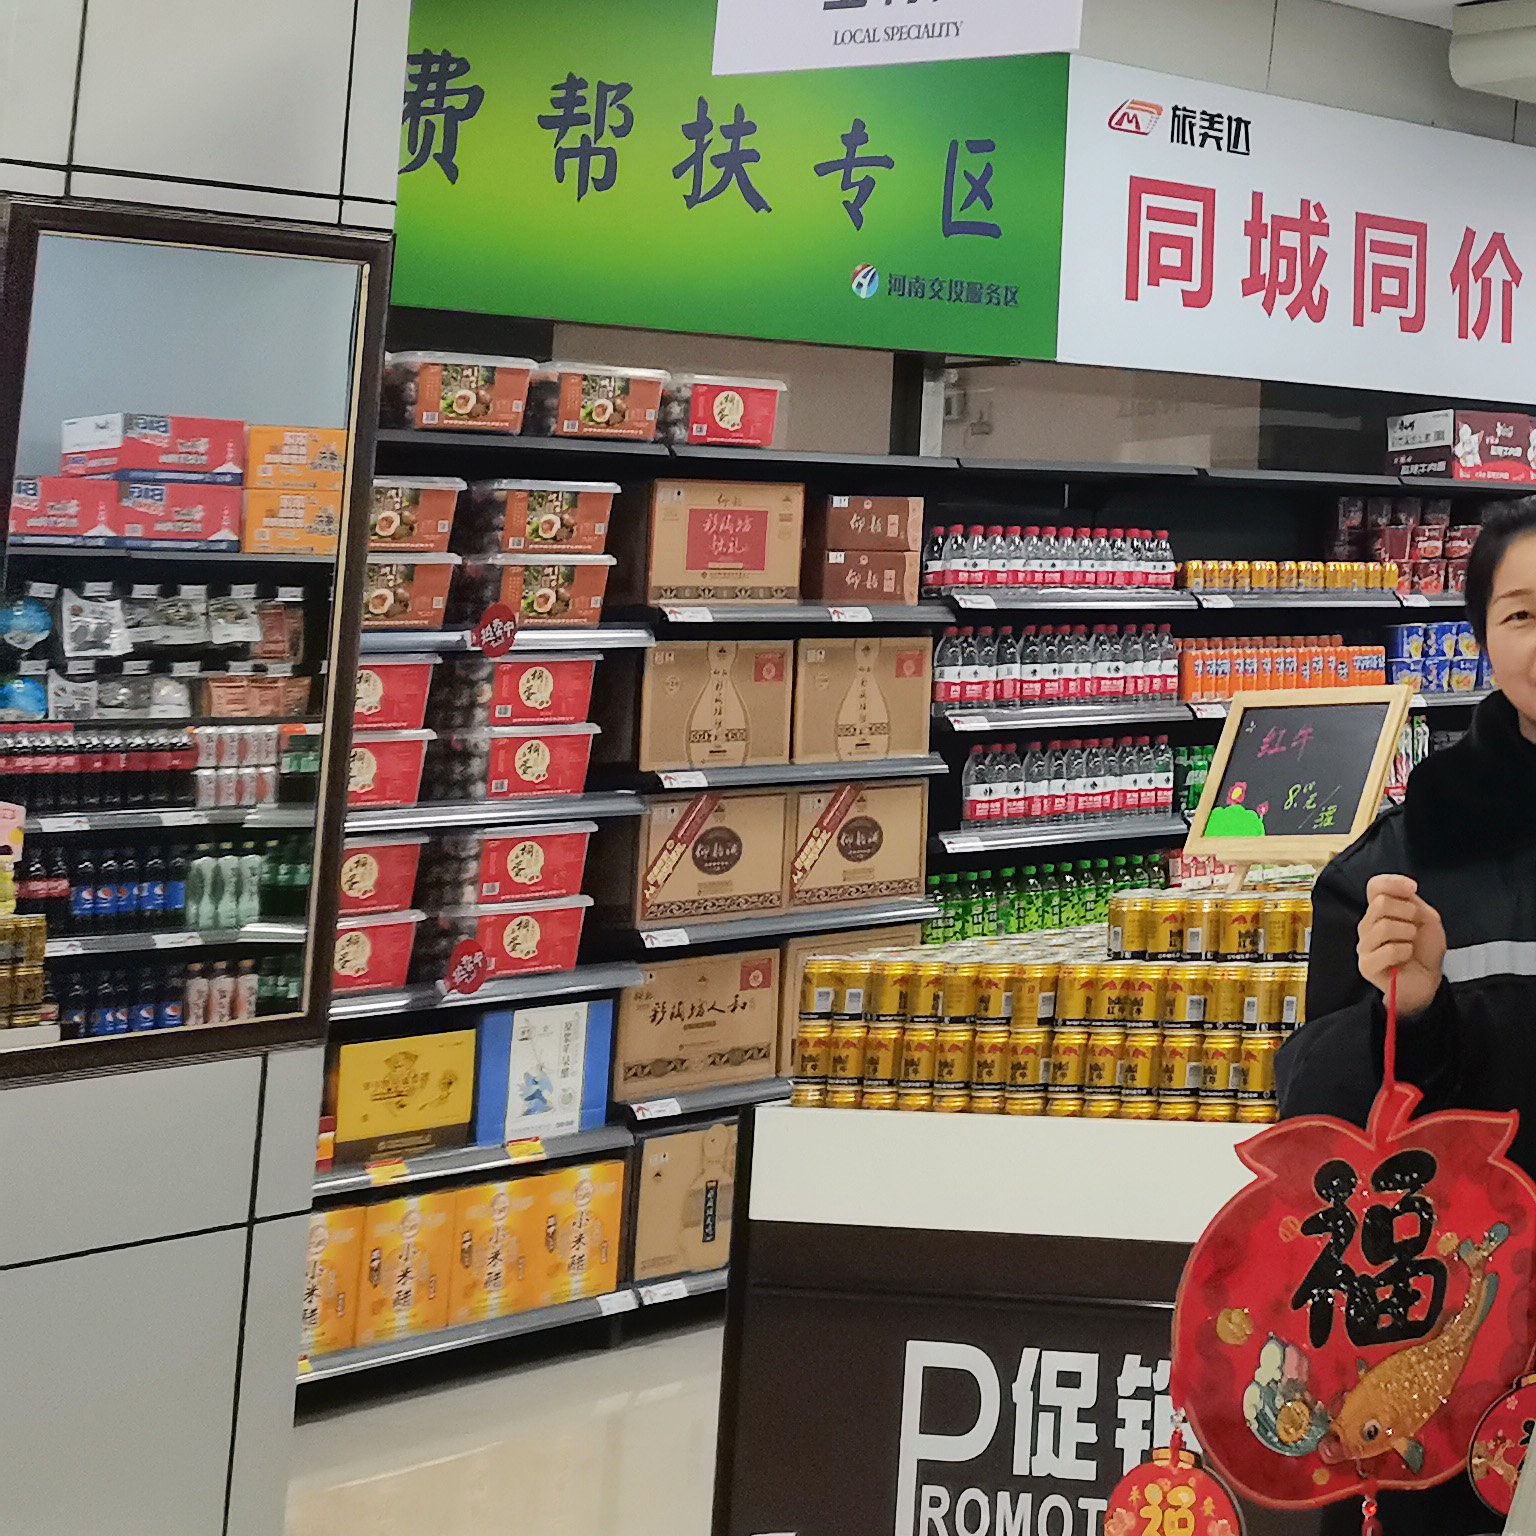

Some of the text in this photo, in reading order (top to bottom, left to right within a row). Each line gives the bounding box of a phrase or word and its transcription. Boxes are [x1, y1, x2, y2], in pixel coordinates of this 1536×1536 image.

[833, 20, 964, 46] LOCAL SPECIALITY
[398, 47, 1003, 239] 费帮扶专区
[1169, 103, 1252, 156] 旅美达
[886, 272, 1020, 308] 河南交投服务区
[1289, 1149, 1449, 1349] 福
